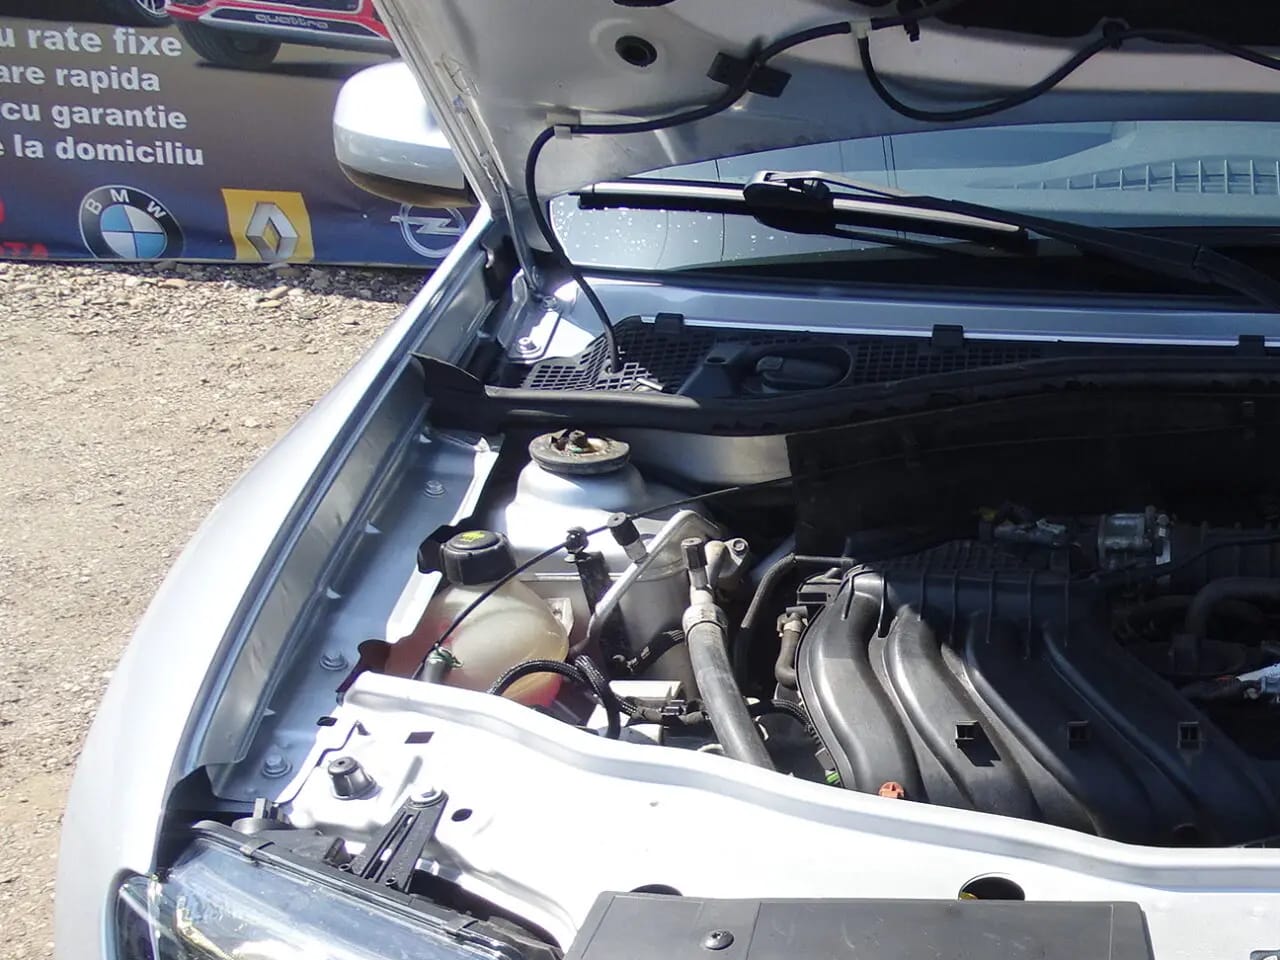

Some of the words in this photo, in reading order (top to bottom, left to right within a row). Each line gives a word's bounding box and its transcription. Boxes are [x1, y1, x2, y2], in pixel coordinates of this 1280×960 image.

[27, 26, 102, 52] rate
[113, 27, 182, 56] fixe
[55, 65, 160, 94] rapida
[1, 101, 41, 121] cu
[51, 104, 187, 129] garantie
[13, 134, 44, 158] la
[55, 136, 204, 165] domiciliu
[84, 188, 167, 220] BMW
